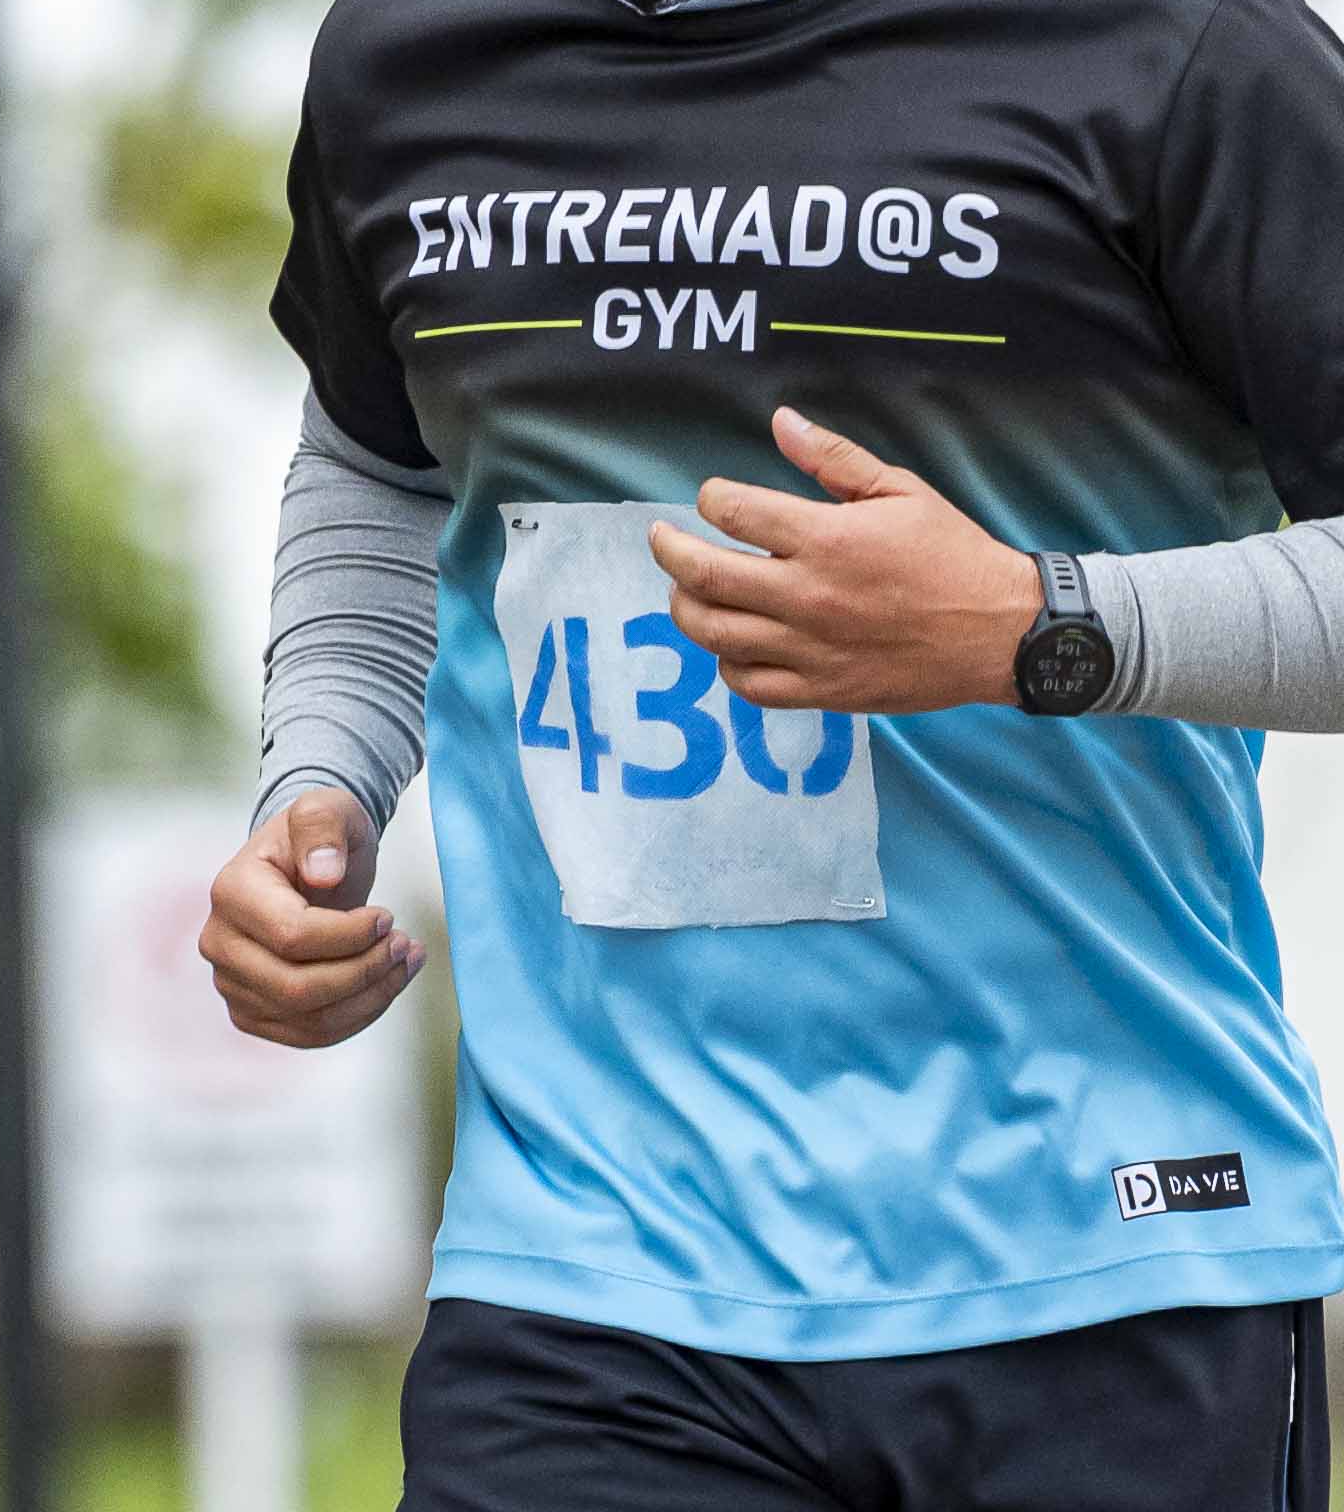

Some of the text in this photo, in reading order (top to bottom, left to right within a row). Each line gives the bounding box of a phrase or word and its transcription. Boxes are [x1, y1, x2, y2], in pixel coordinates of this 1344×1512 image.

[408, 185, 1000, 279] ENTRENAD@S
[592, 288, 756, 352] GYM
[1168, 1170, 1240, 1196] DAVE
